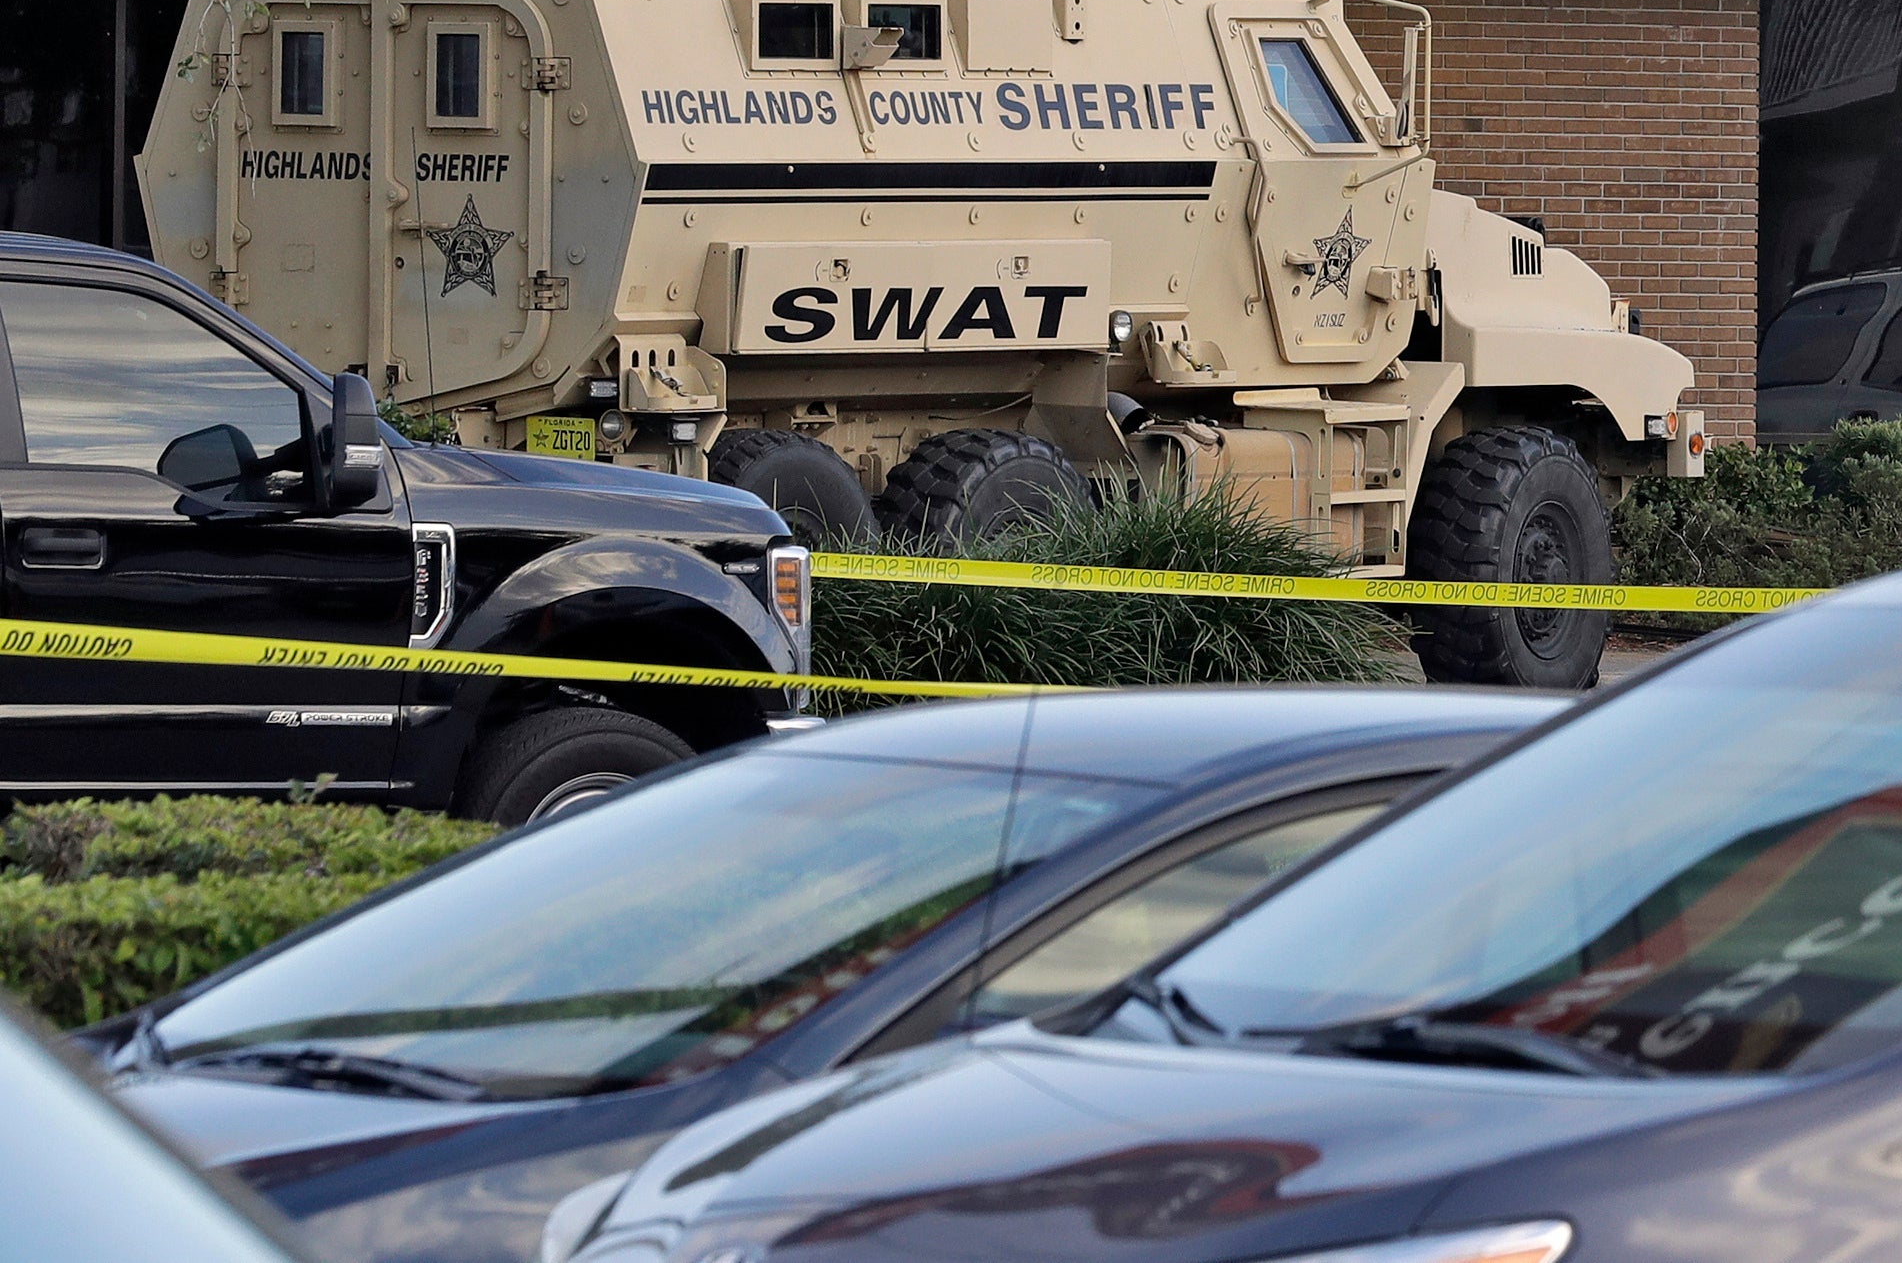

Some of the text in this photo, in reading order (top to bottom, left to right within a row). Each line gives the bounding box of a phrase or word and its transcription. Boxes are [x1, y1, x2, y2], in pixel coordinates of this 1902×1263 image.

[641, 83, 1215, 130] HIGHLANDS COUNTY SHERIFF
[416, 153, 510, 182] SHERIFF
[764, 286, 1088, 343] SWAT
[544, 419, 576, 427] FLORIDA
[552, 429, 591, 451] ZGT20
[1, 630, 133, 656] CAUTION DO
[306, 714, 342, 722] POWER
[346, 714, 390, 722] STROKE
